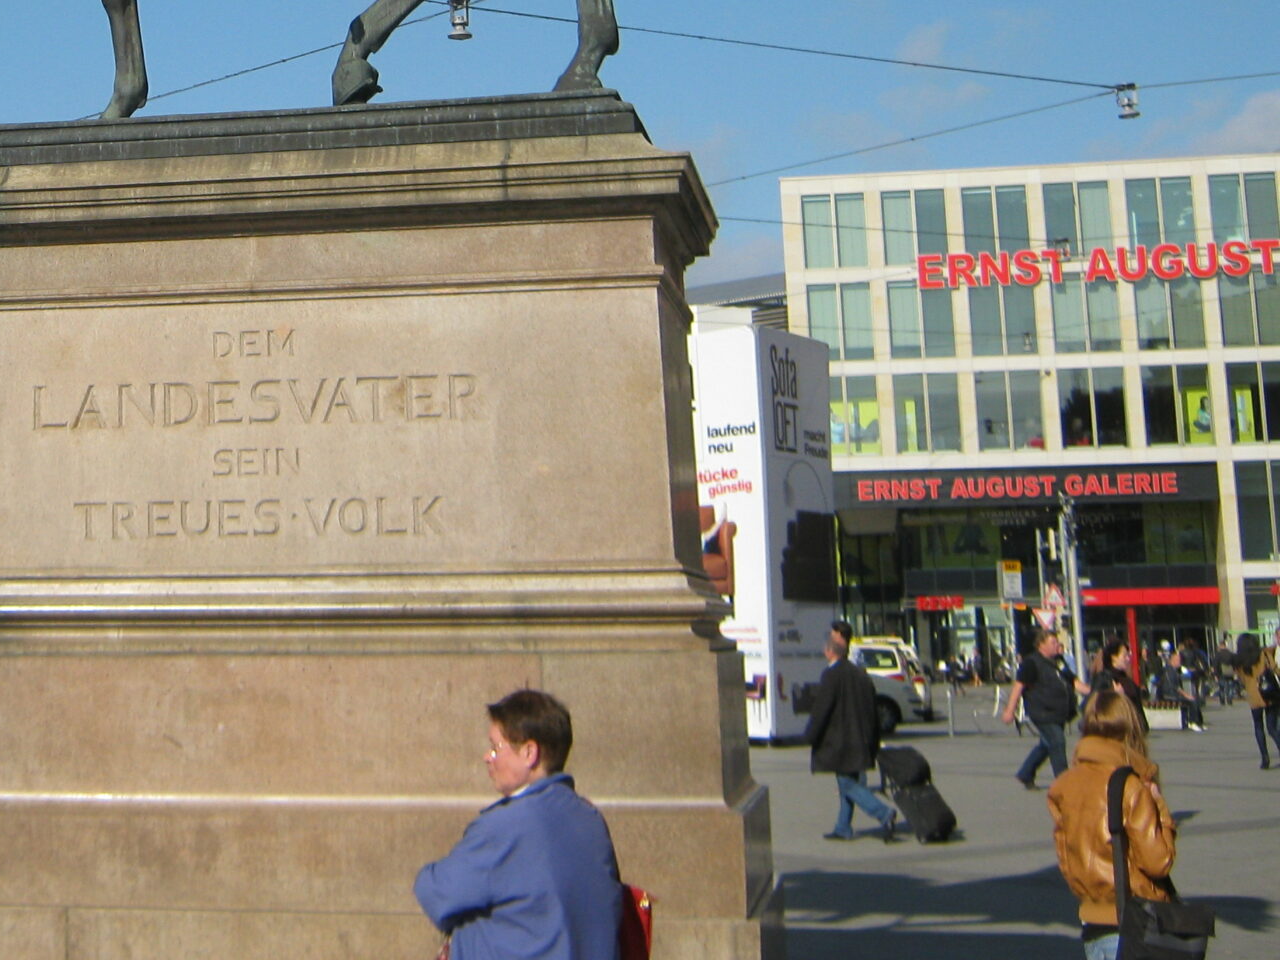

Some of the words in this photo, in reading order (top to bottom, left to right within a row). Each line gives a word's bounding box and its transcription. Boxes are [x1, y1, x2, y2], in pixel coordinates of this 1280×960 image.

[917, 249, 1069, 290] ERNST
[1084, 239, 1280, 283] AUGUST
[212, 328, 296, 358] DEM
[771, 344, 798, 399] Sofa
[32, 373, 486, 431] LANDESVATER
[707, 421, 757, 439] laufend
[212, 446, 301, 478] SEIN
[708, 442, 734, 455] neu
[697, 468, 738, 484] tücke
[708, 480, 753, 499] günstig
[857, 478, 942, 501] ERNST
[950, 475, 1056, 500] AUGUST
[1064, 472, 1178, 496] GALERIE
